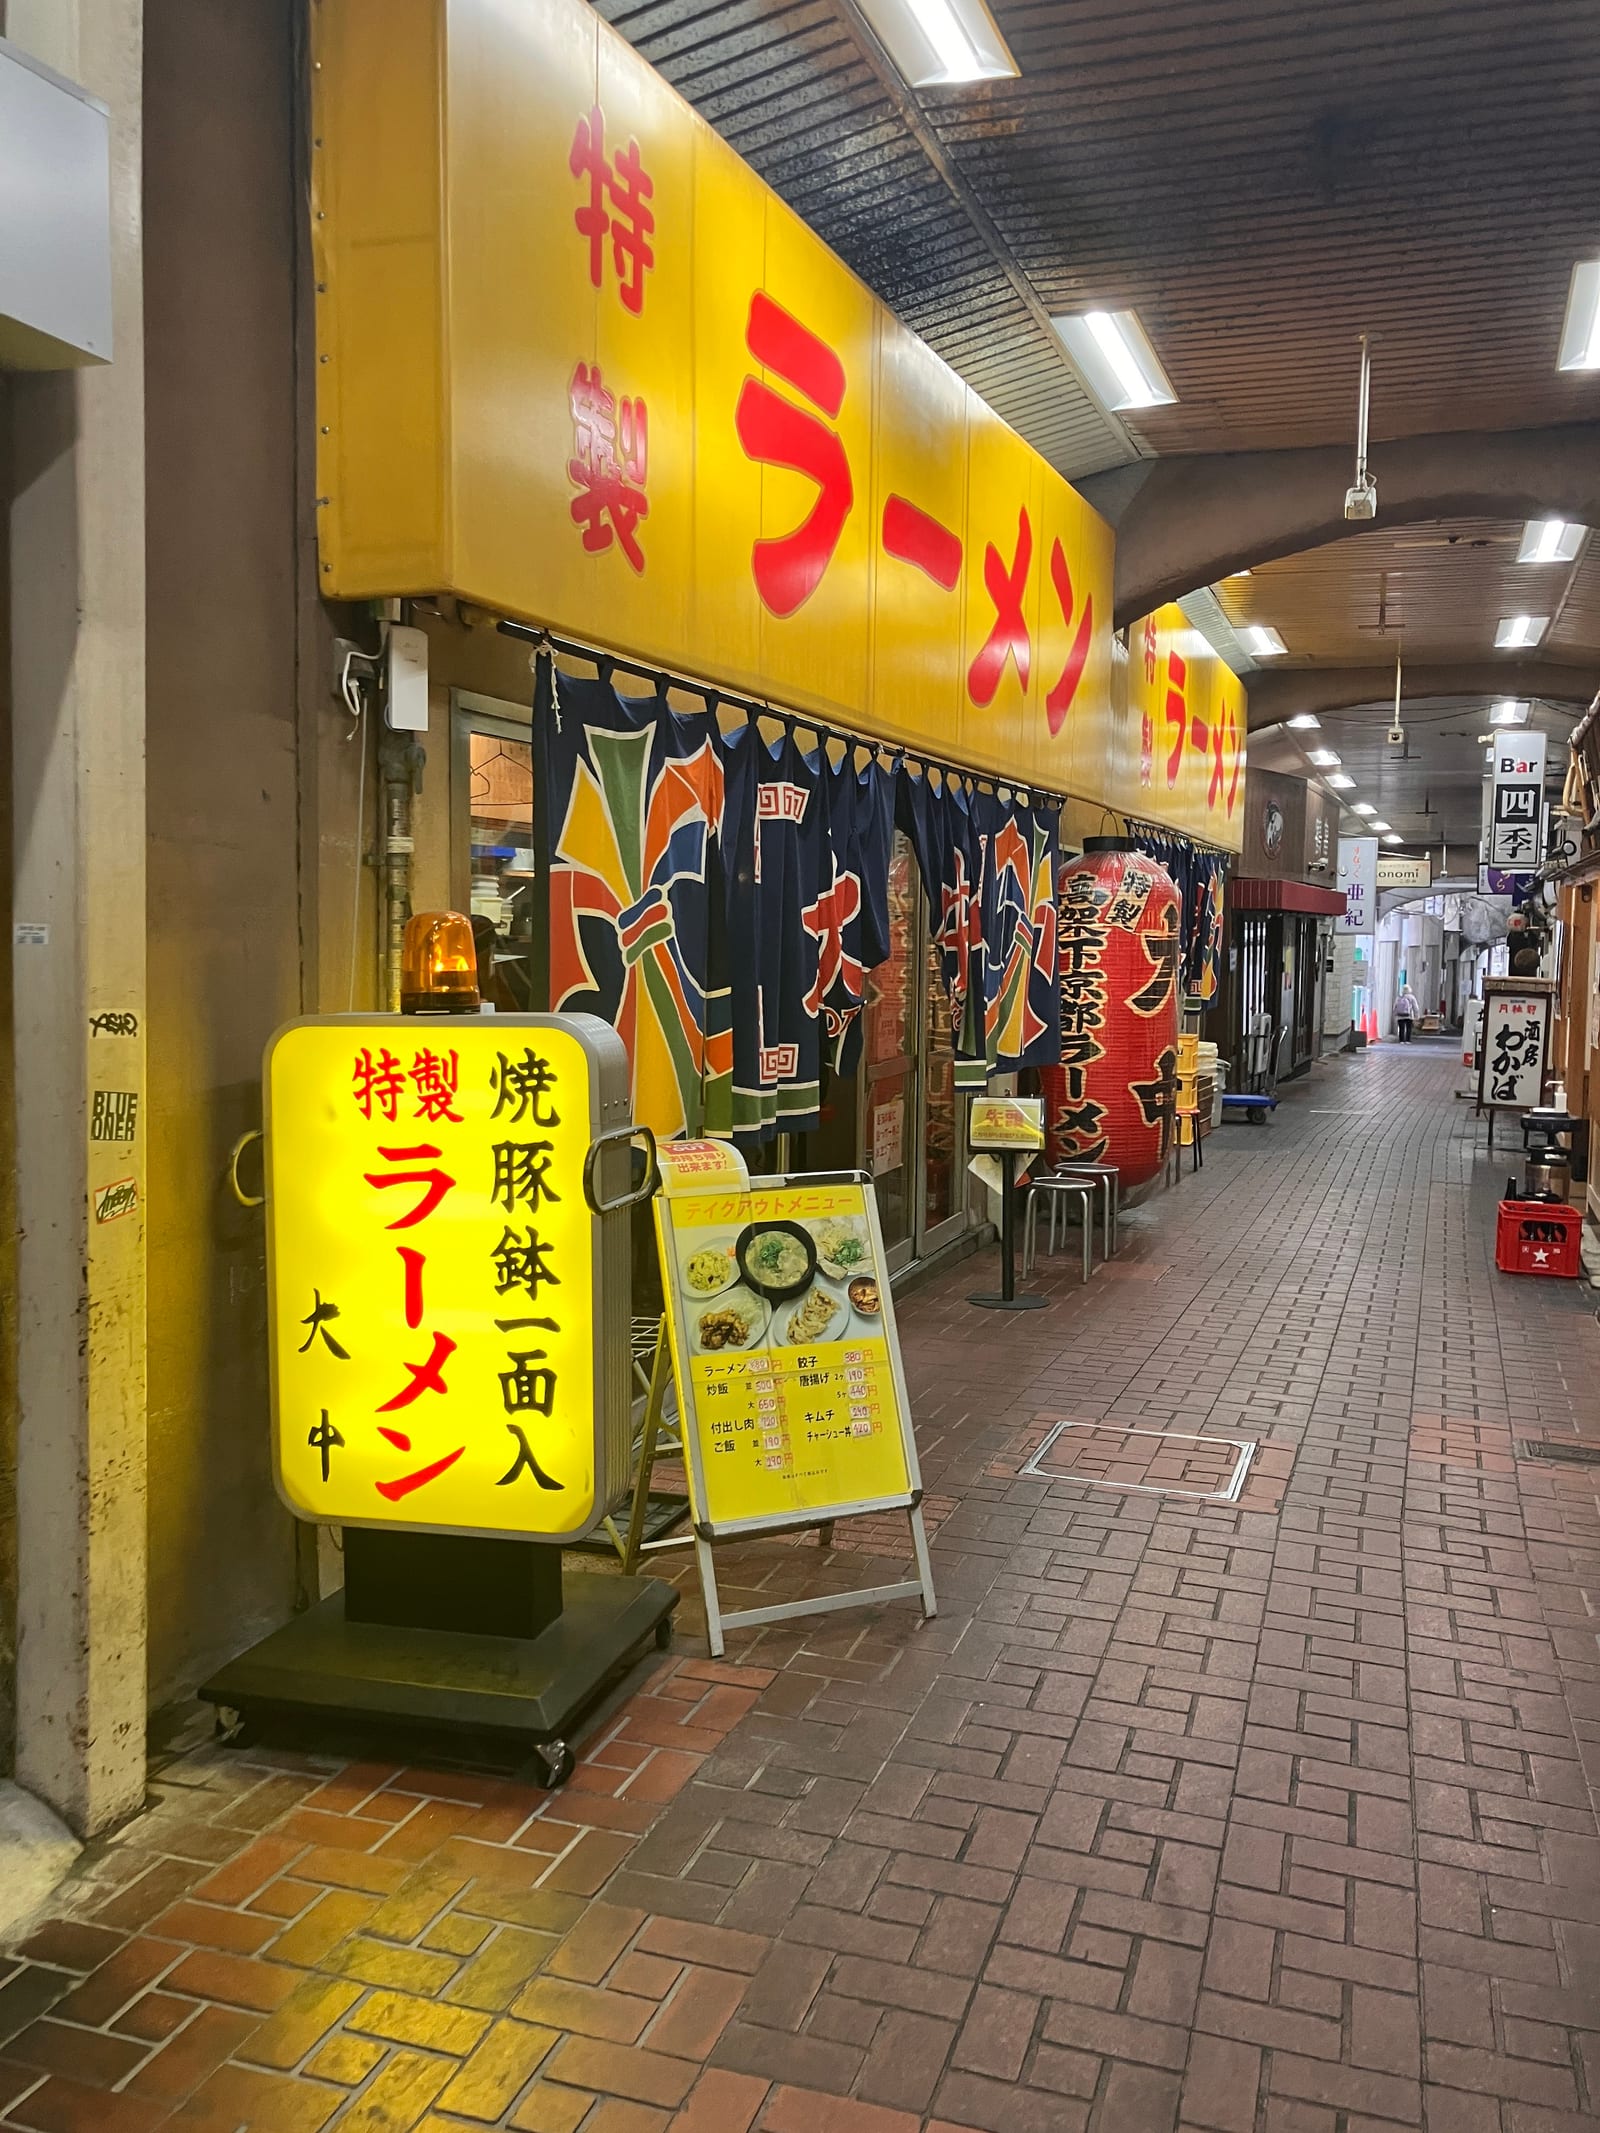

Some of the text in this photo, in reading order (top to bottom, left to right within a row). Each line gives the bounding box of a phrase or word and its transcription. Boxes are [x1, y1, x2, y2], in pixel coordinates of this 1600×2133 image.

[569, 103, 656, 578] 特製
[734, 287, 1093, 738] ラーメン
[1165, 650, 1243, 820] ラーメン
[1501, 757, 1538, 774] Bar
[1498, 789, 1537, 859] 四季
[1377, 868, 1419, 878] onomi
[1107, 868, 1149, 932] 特製
[1344, 883, 1365, 926] 亜紀
[1491, 1023, 1526, 1101] わかば
[93, 1092, 137, 1118] BLUE
[352, 1047, 464, 1123] 特製
[686, 1194, 854, 1221] テイクアウトメニュー
[490, 1047, 565, 1491] 焼豚鉢一面入
[363, 1143, 466, 1502] ラーメン
[704, 1363, 747, 1377] ラーメン
[797, 1356, 818, 1368] 餃子
[799, 1372, 829, 1387] 唐揚げ
[804, 1409, 835, 1423] キムチ
[714, 1439, 735, 1453] ご飯
